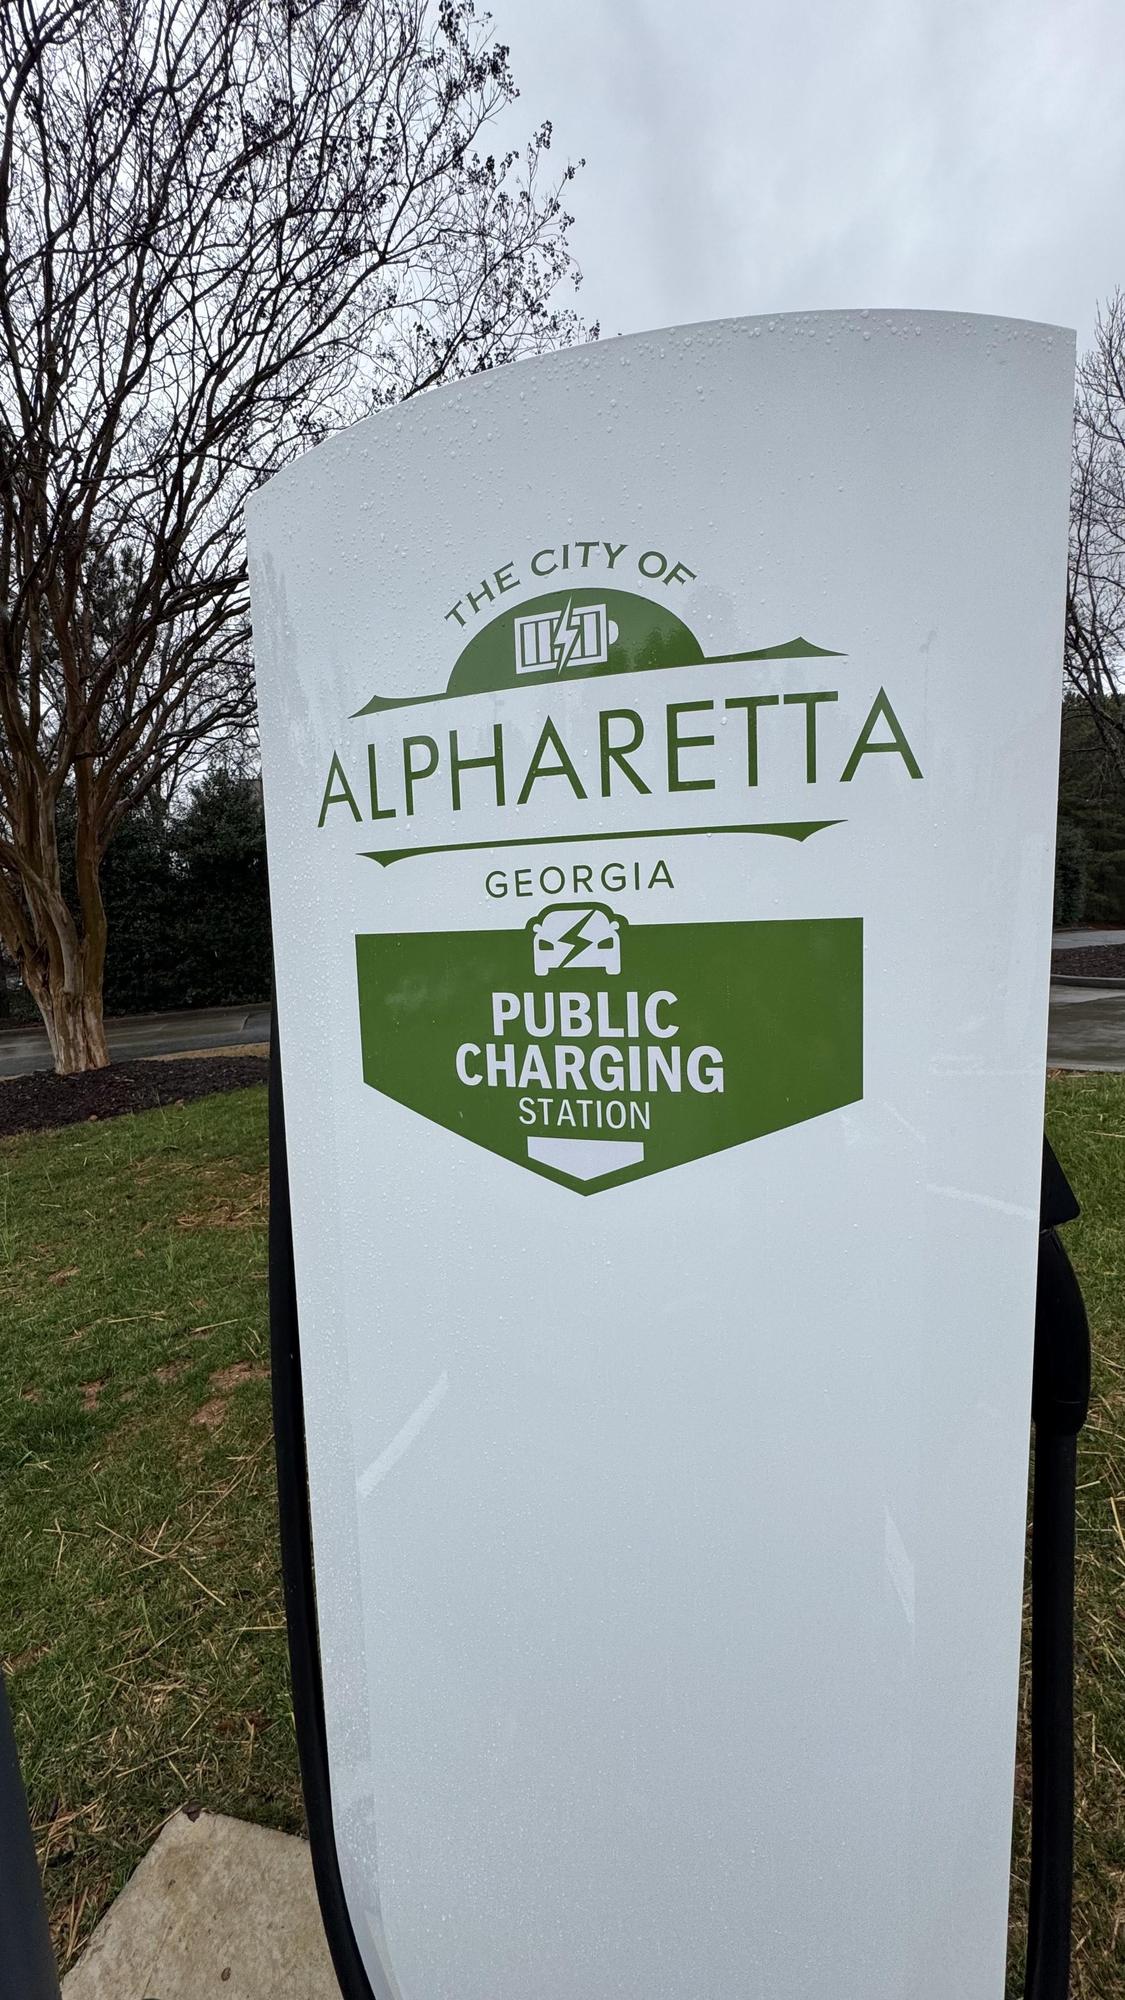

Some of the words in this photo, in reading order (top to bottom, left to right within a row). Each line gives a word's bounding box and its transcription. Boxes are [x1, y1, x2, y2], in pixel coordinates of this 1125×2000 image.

[444, 561, 521, 628] THE
[530, 540, 628, 577] CITY
[637, 550, 697, 587] OF
[317, 686, 924, 828] ALPHARETTA
[485, 860, 675, 898] GEORGIA
[491, 990, 680, 1039] PUBLIC
[455, 1042, 725, 1094] CHARGING
[518, 1097, 651, 1130] STATION
